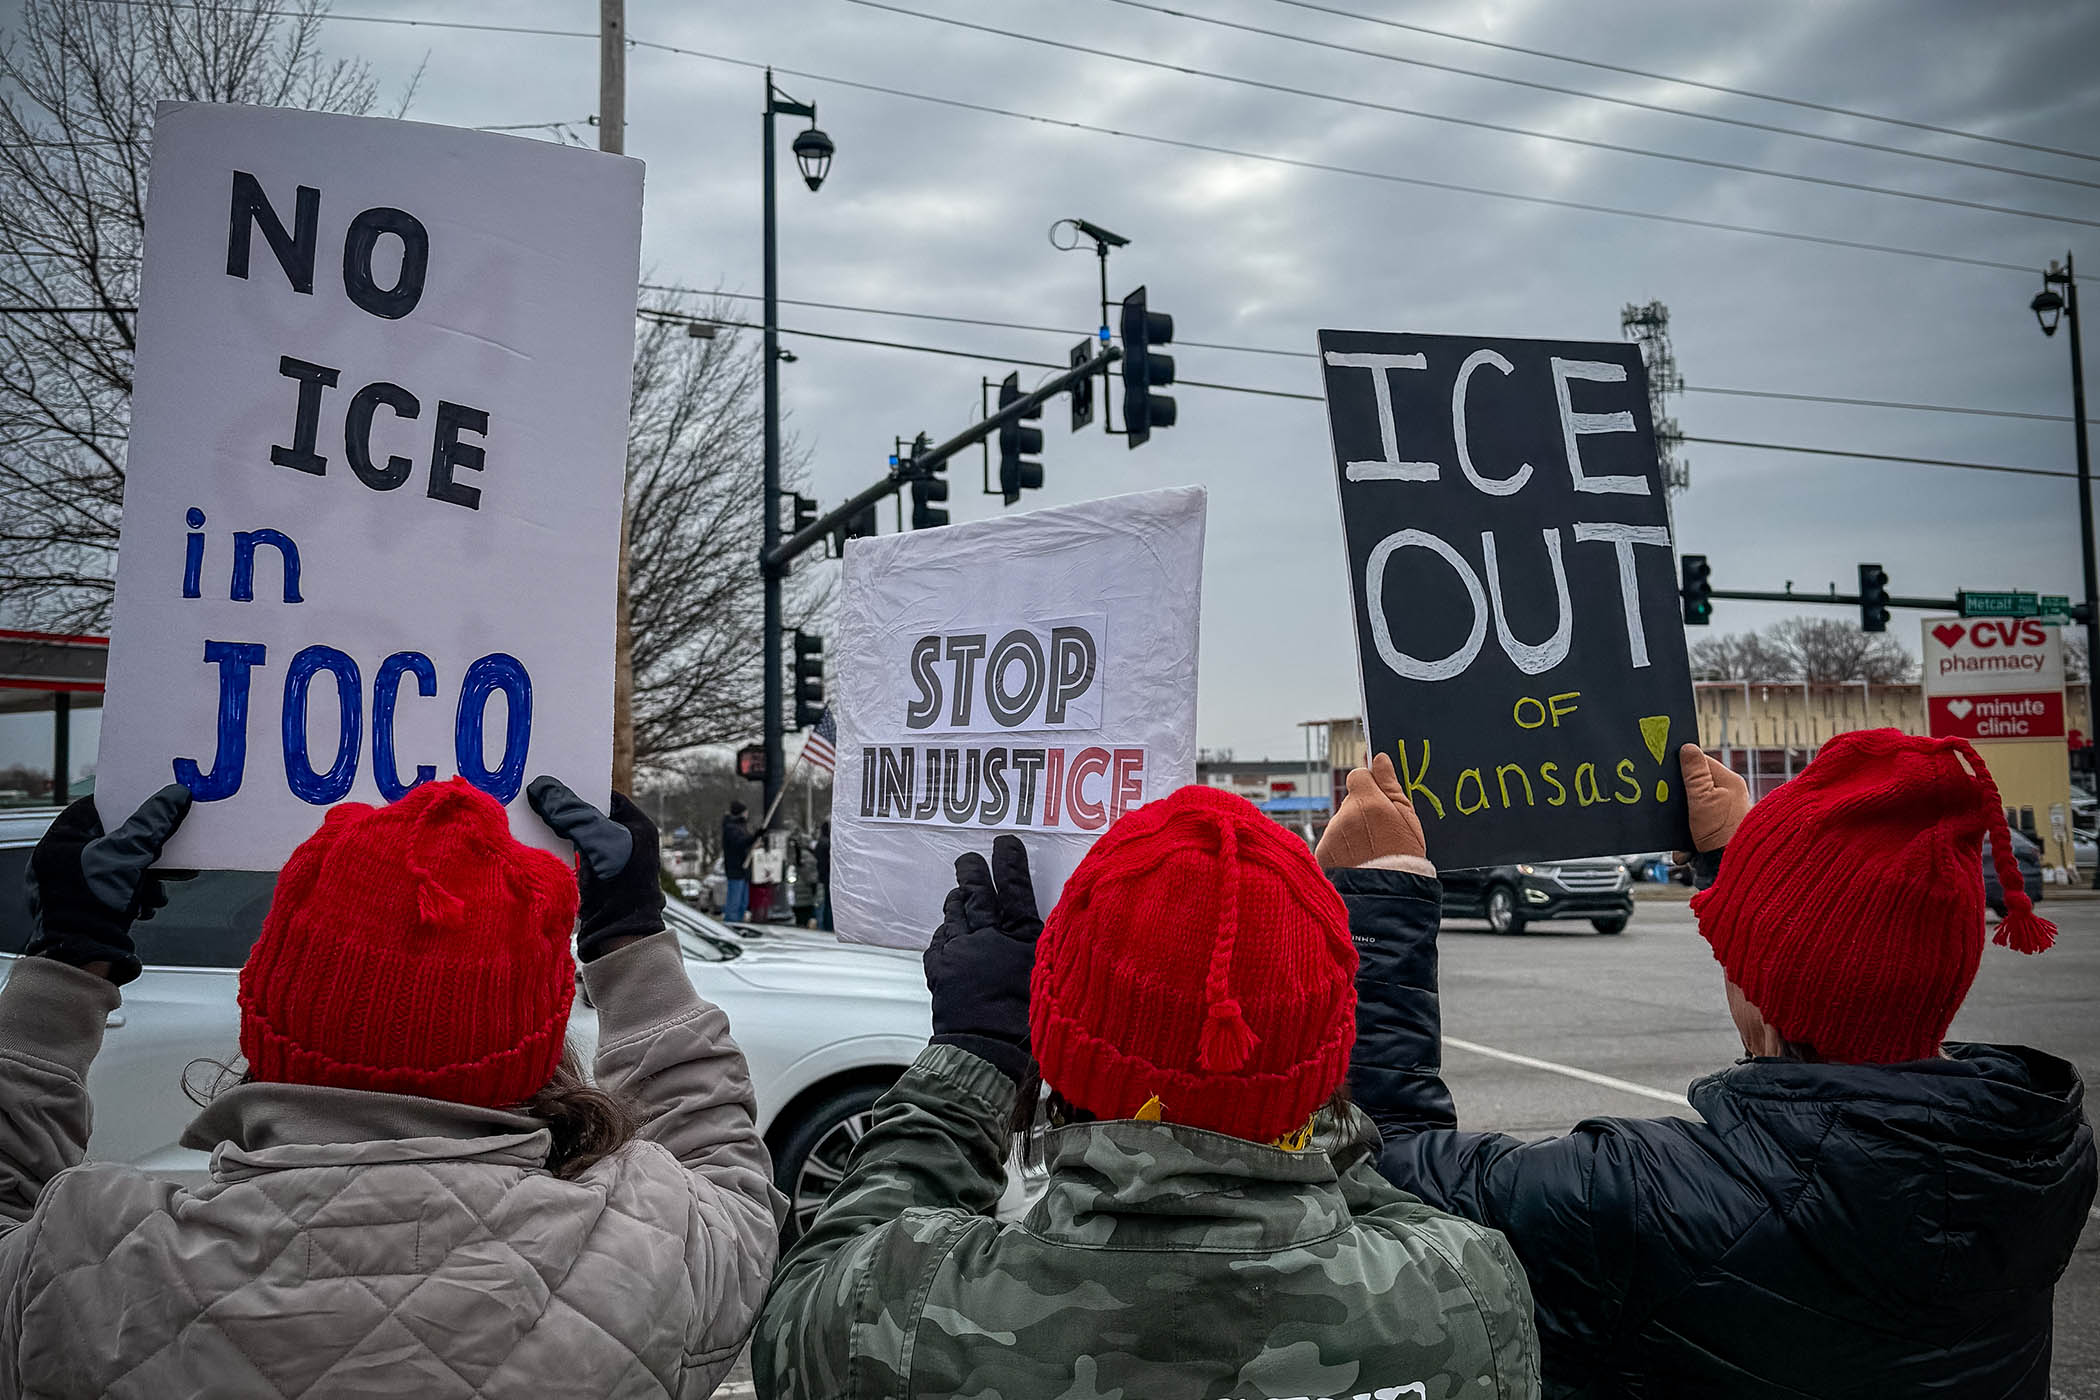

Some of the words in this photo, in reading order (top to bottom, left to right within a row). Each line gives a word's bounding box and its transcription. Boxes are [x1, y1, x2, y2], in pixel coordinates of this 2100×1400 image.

[226, 170, 429, 320] NO
[270, 355, 490, 511] ICE
[1324, 349, 1652, 497] ICE
[182, 507, 304, 604] in
[1366, 520, 1672, 682] OUT
[1968, 598, 2012, 610] Metcalf
[906, 626, 1097, 730] STOP
[1940, 654, 2045, 675] pharmacy
[1970, 621, 2046, 647] CVS
[172, 640, 532, 806] JOCO
[1513, 692, 1582, 728] OF
[1976, 699, 2045, 716] minute
[1977, 718, 2029, 735] clinic
[860, 746, 1145, 831] INJUSTICE
[1398, 714, 1671, 820] Kansas!
